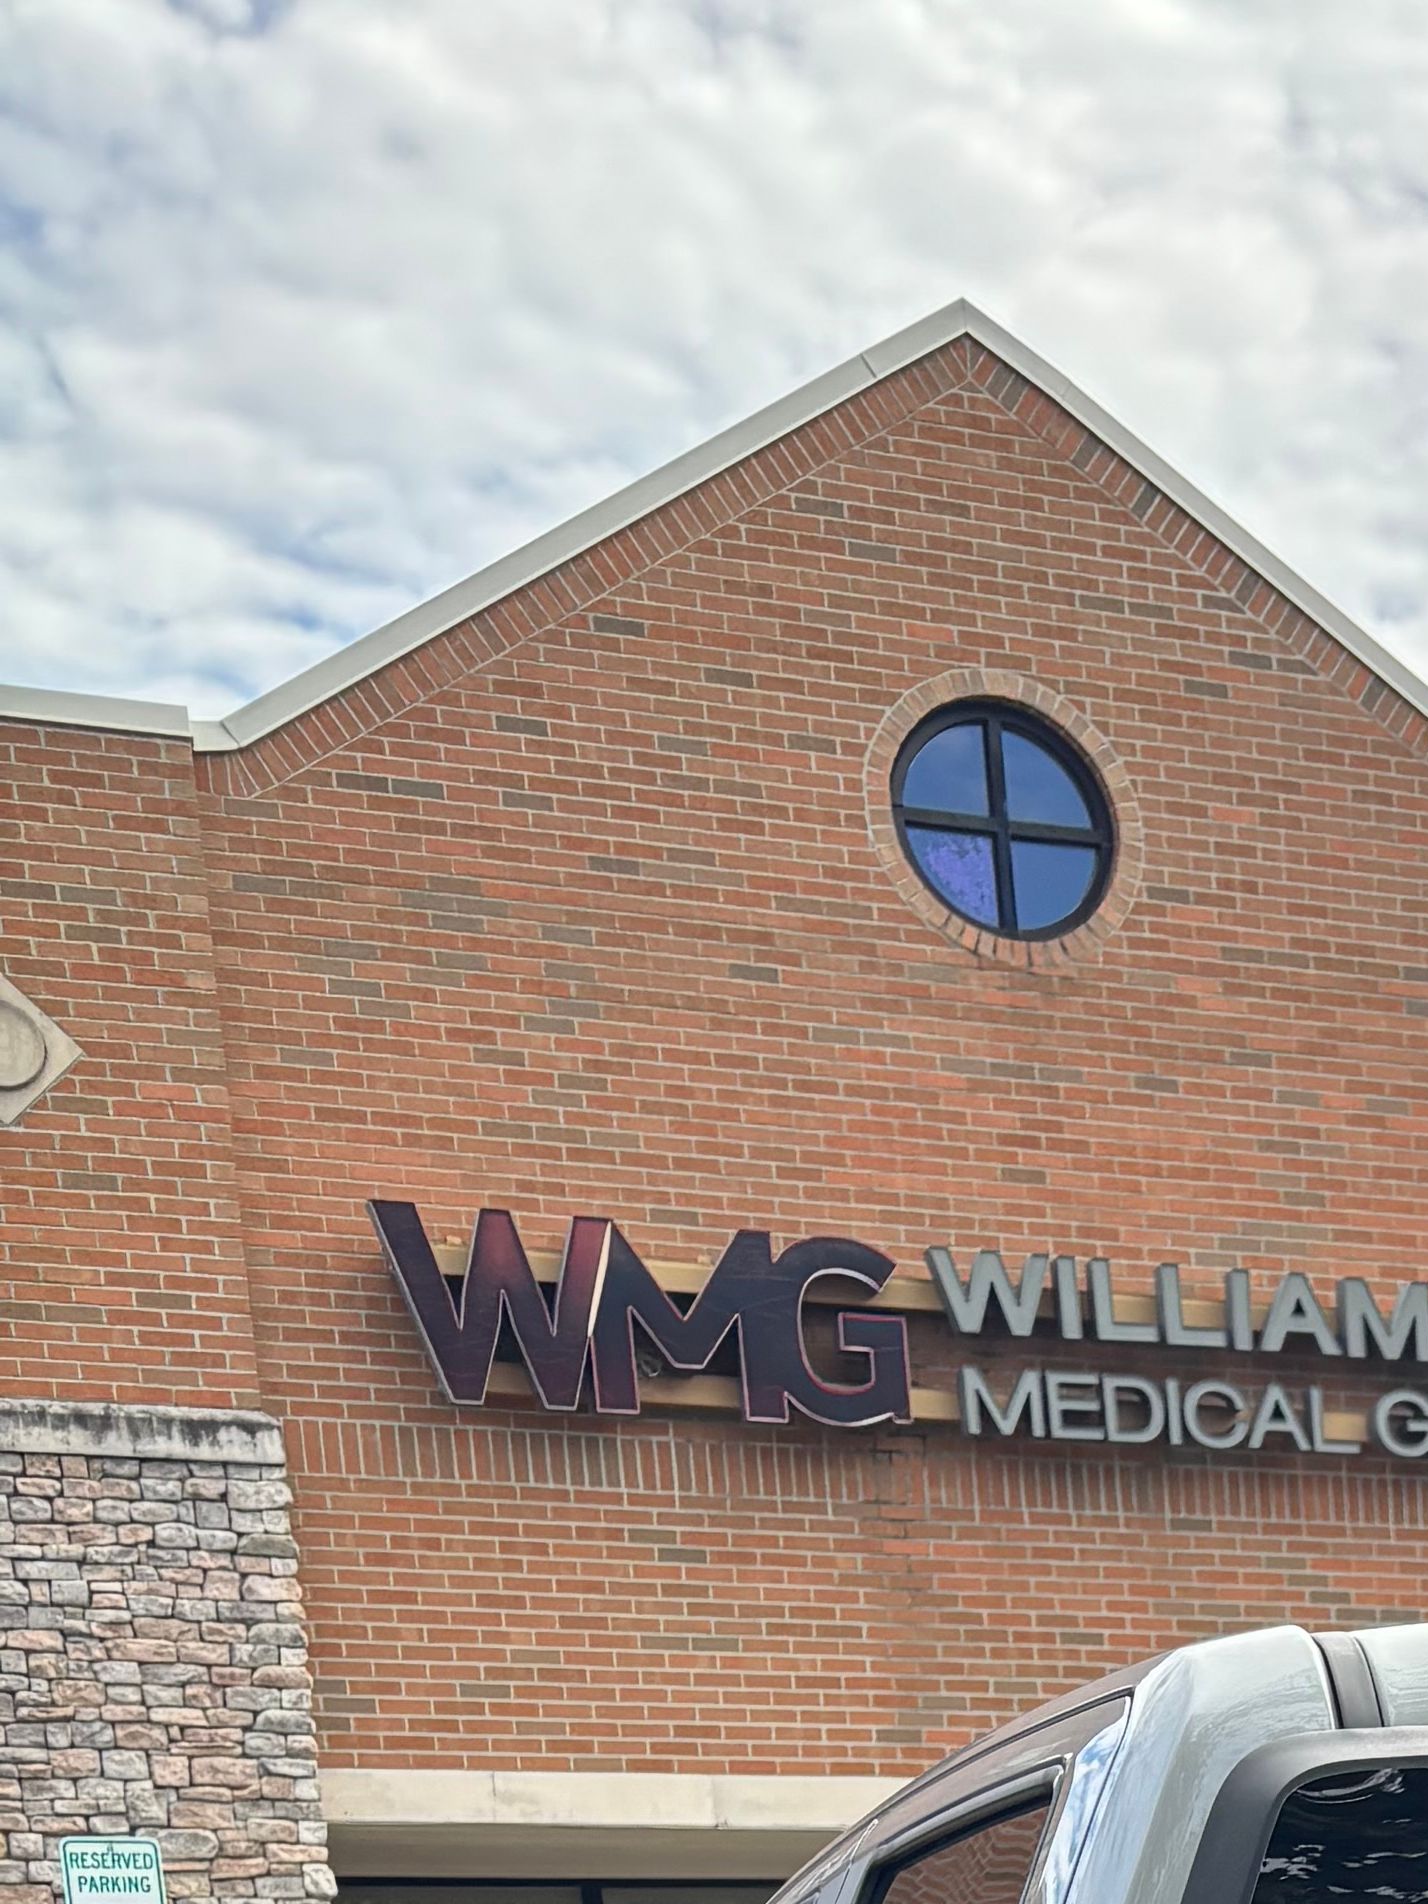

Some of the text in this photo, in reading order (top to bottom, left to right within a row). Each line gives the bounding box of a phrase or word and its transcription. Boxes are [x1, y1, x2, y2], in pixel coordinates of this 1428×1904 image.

[367, 1200, 911, 1427] WMG
[955, 1365, 1363, 1455] MEDICAL
[69, 1852, 154, 1870] RESERVED
[77, 1875, 152, 1894] PARKING
